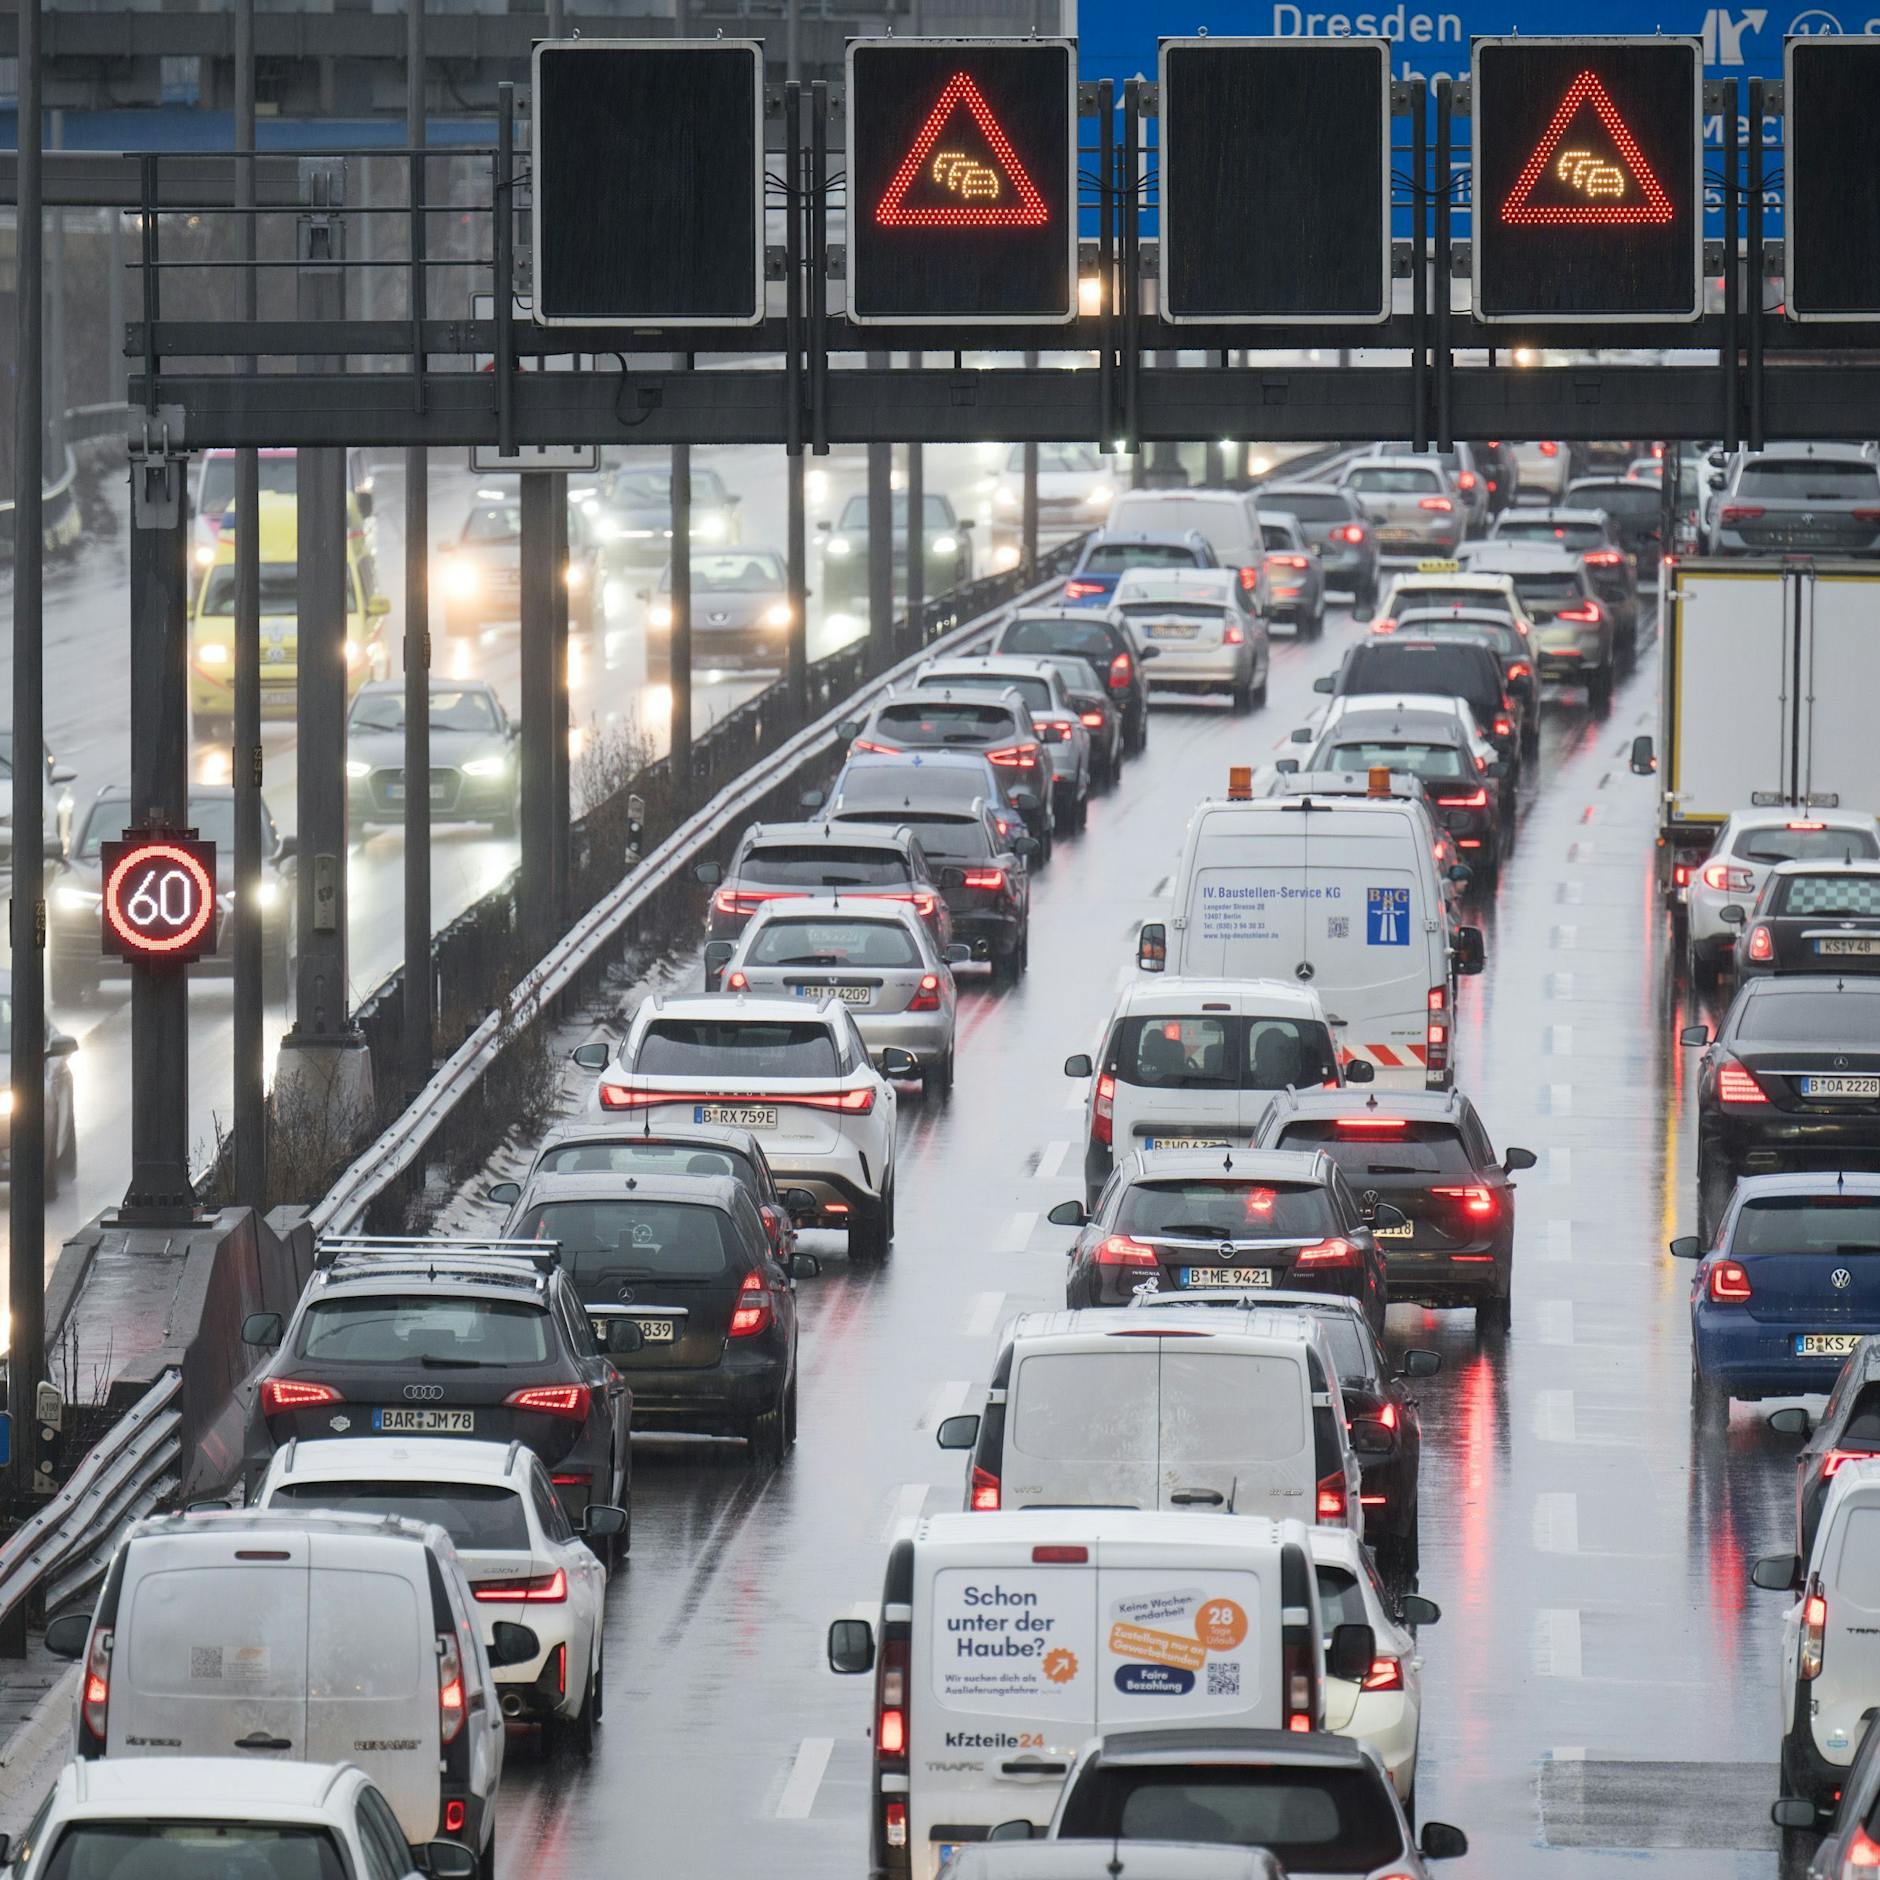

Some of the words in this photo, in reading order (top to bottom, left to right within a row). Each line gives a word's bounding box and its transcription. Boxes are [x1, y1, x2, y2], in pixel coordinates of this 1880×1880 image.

[1273, 4, 1462, 42] Dresden
[128, 871, 190, 925] 60
[1219, 887, 1322, 898] Baustellen-Service
[1326, 887, 1341, 898] KG
[1825, 941, 1840, 952] KS
[1811, 1081, 1818, 1091] B
[1828, 1081, 1843, 1092] OA
[1847, 1081, 1877, 1092] 2228
[703, 1110, 712, 1123] B
[720, 1110, 737, 1123] RX
[740, 1110, 775, 1123] 759E
[1191, 1270, 1200, 1283] B
[1210, 1270, 1229, 1283] ME
[1234, 1270, 1269, 1284] 9421
[639, 1322, 671, 1336] 839
[1805, 1338, 1814, 1350] B
[1825, 1338, 1844, 1350] KS
[383, 1412, 415, 1427] BAR
[427, 1412, 448, 1428] JM
[451, 1414, 472, 1429] 78
[963, 1585, 1037, 1606] Schon
[1120, 1602, 1149, 1613] Keine
[1134, 1607, 1185, 1622] endarbeit
[947, 1614, 1009, 1632] unter
[1015, 1610, 1056, 1632] der
[1208, 1607, 1233, 1625] 28
[957, 1635, 1046, 1658] Haube?
[1114, 1626, 1169, 1650] Zustellung
[1170, 1641, 1189, 1652] nur
[1190, 1645, 1205, 1655] an
[1113, 1639, 1201, 1667] Gewerbekunden
[945, 1674, 962, 1683] Wir
[963, 1674, 999, 1682] suchen
[1000, 1673, 1020, 1682] dich
[1022, 1673, 1037, 1682] als
[1140, 1670, 1169, 1681] Faire
[945, 1685, 1040, 1697] Auslieferungsfahrer
[1126, 1680, 1183, 1693] Bezahlung
[945, 1732, 1044, 1749] kfzteile24
[926, 1761, 985, 1772] TRAFIC
